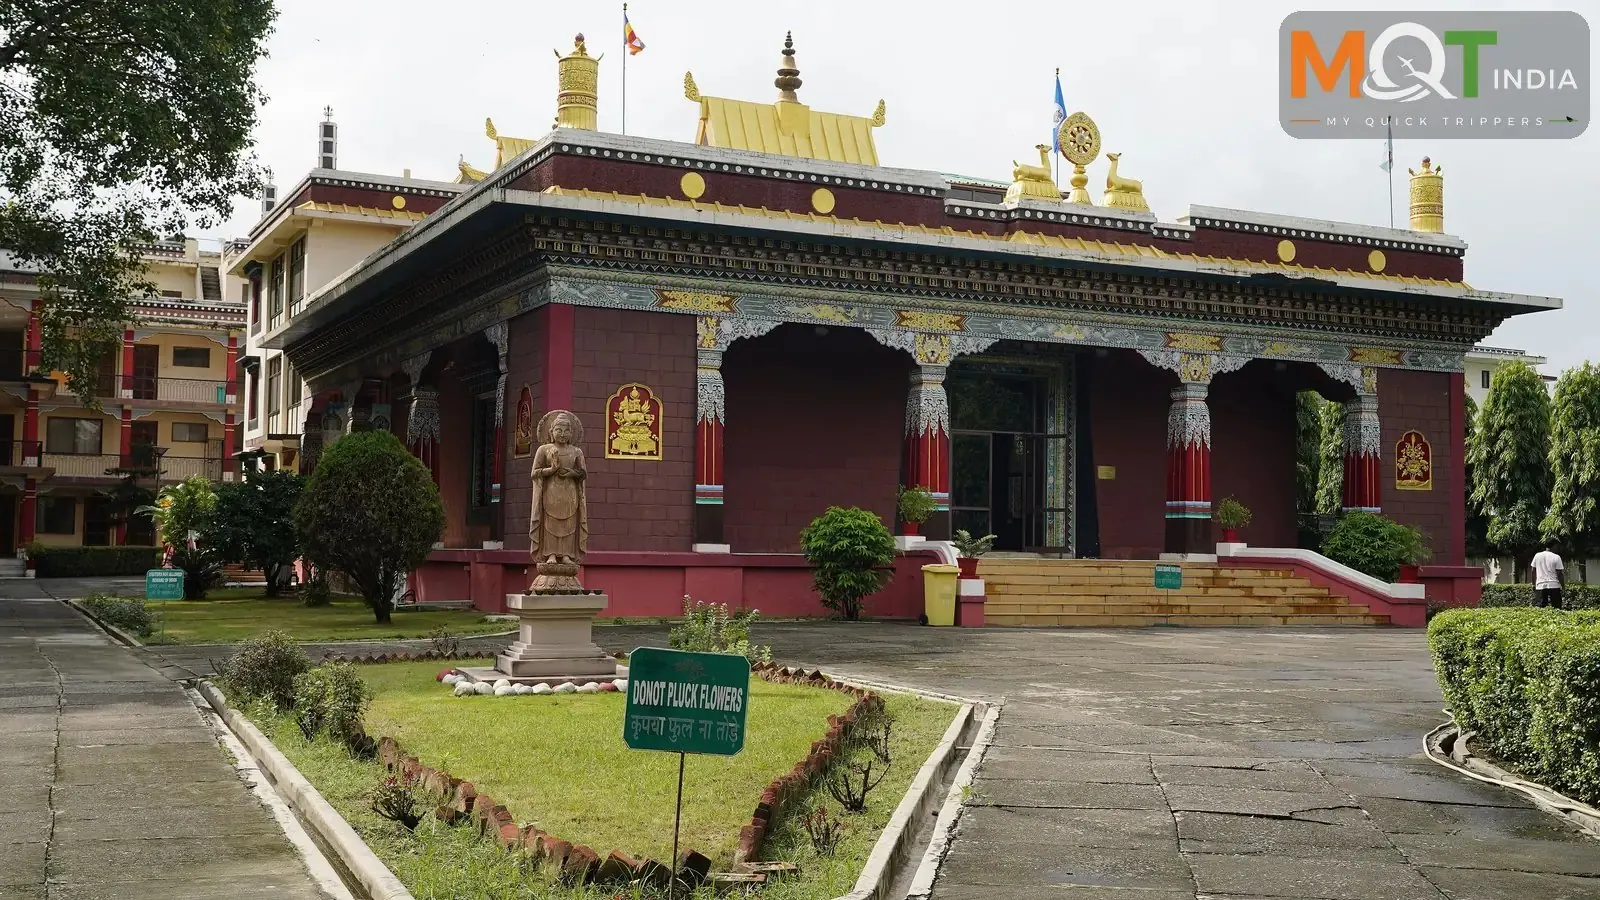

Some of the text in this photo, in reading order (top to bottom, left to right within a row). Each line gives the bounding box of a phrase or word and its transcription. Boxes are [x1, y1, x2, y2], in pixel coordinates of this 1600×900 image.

[632, 680, 743, 713] DONOT PLUCK FLOWERS
[631, 714, 666, 740] कृपया
[699, 719, 713, 741] ना
